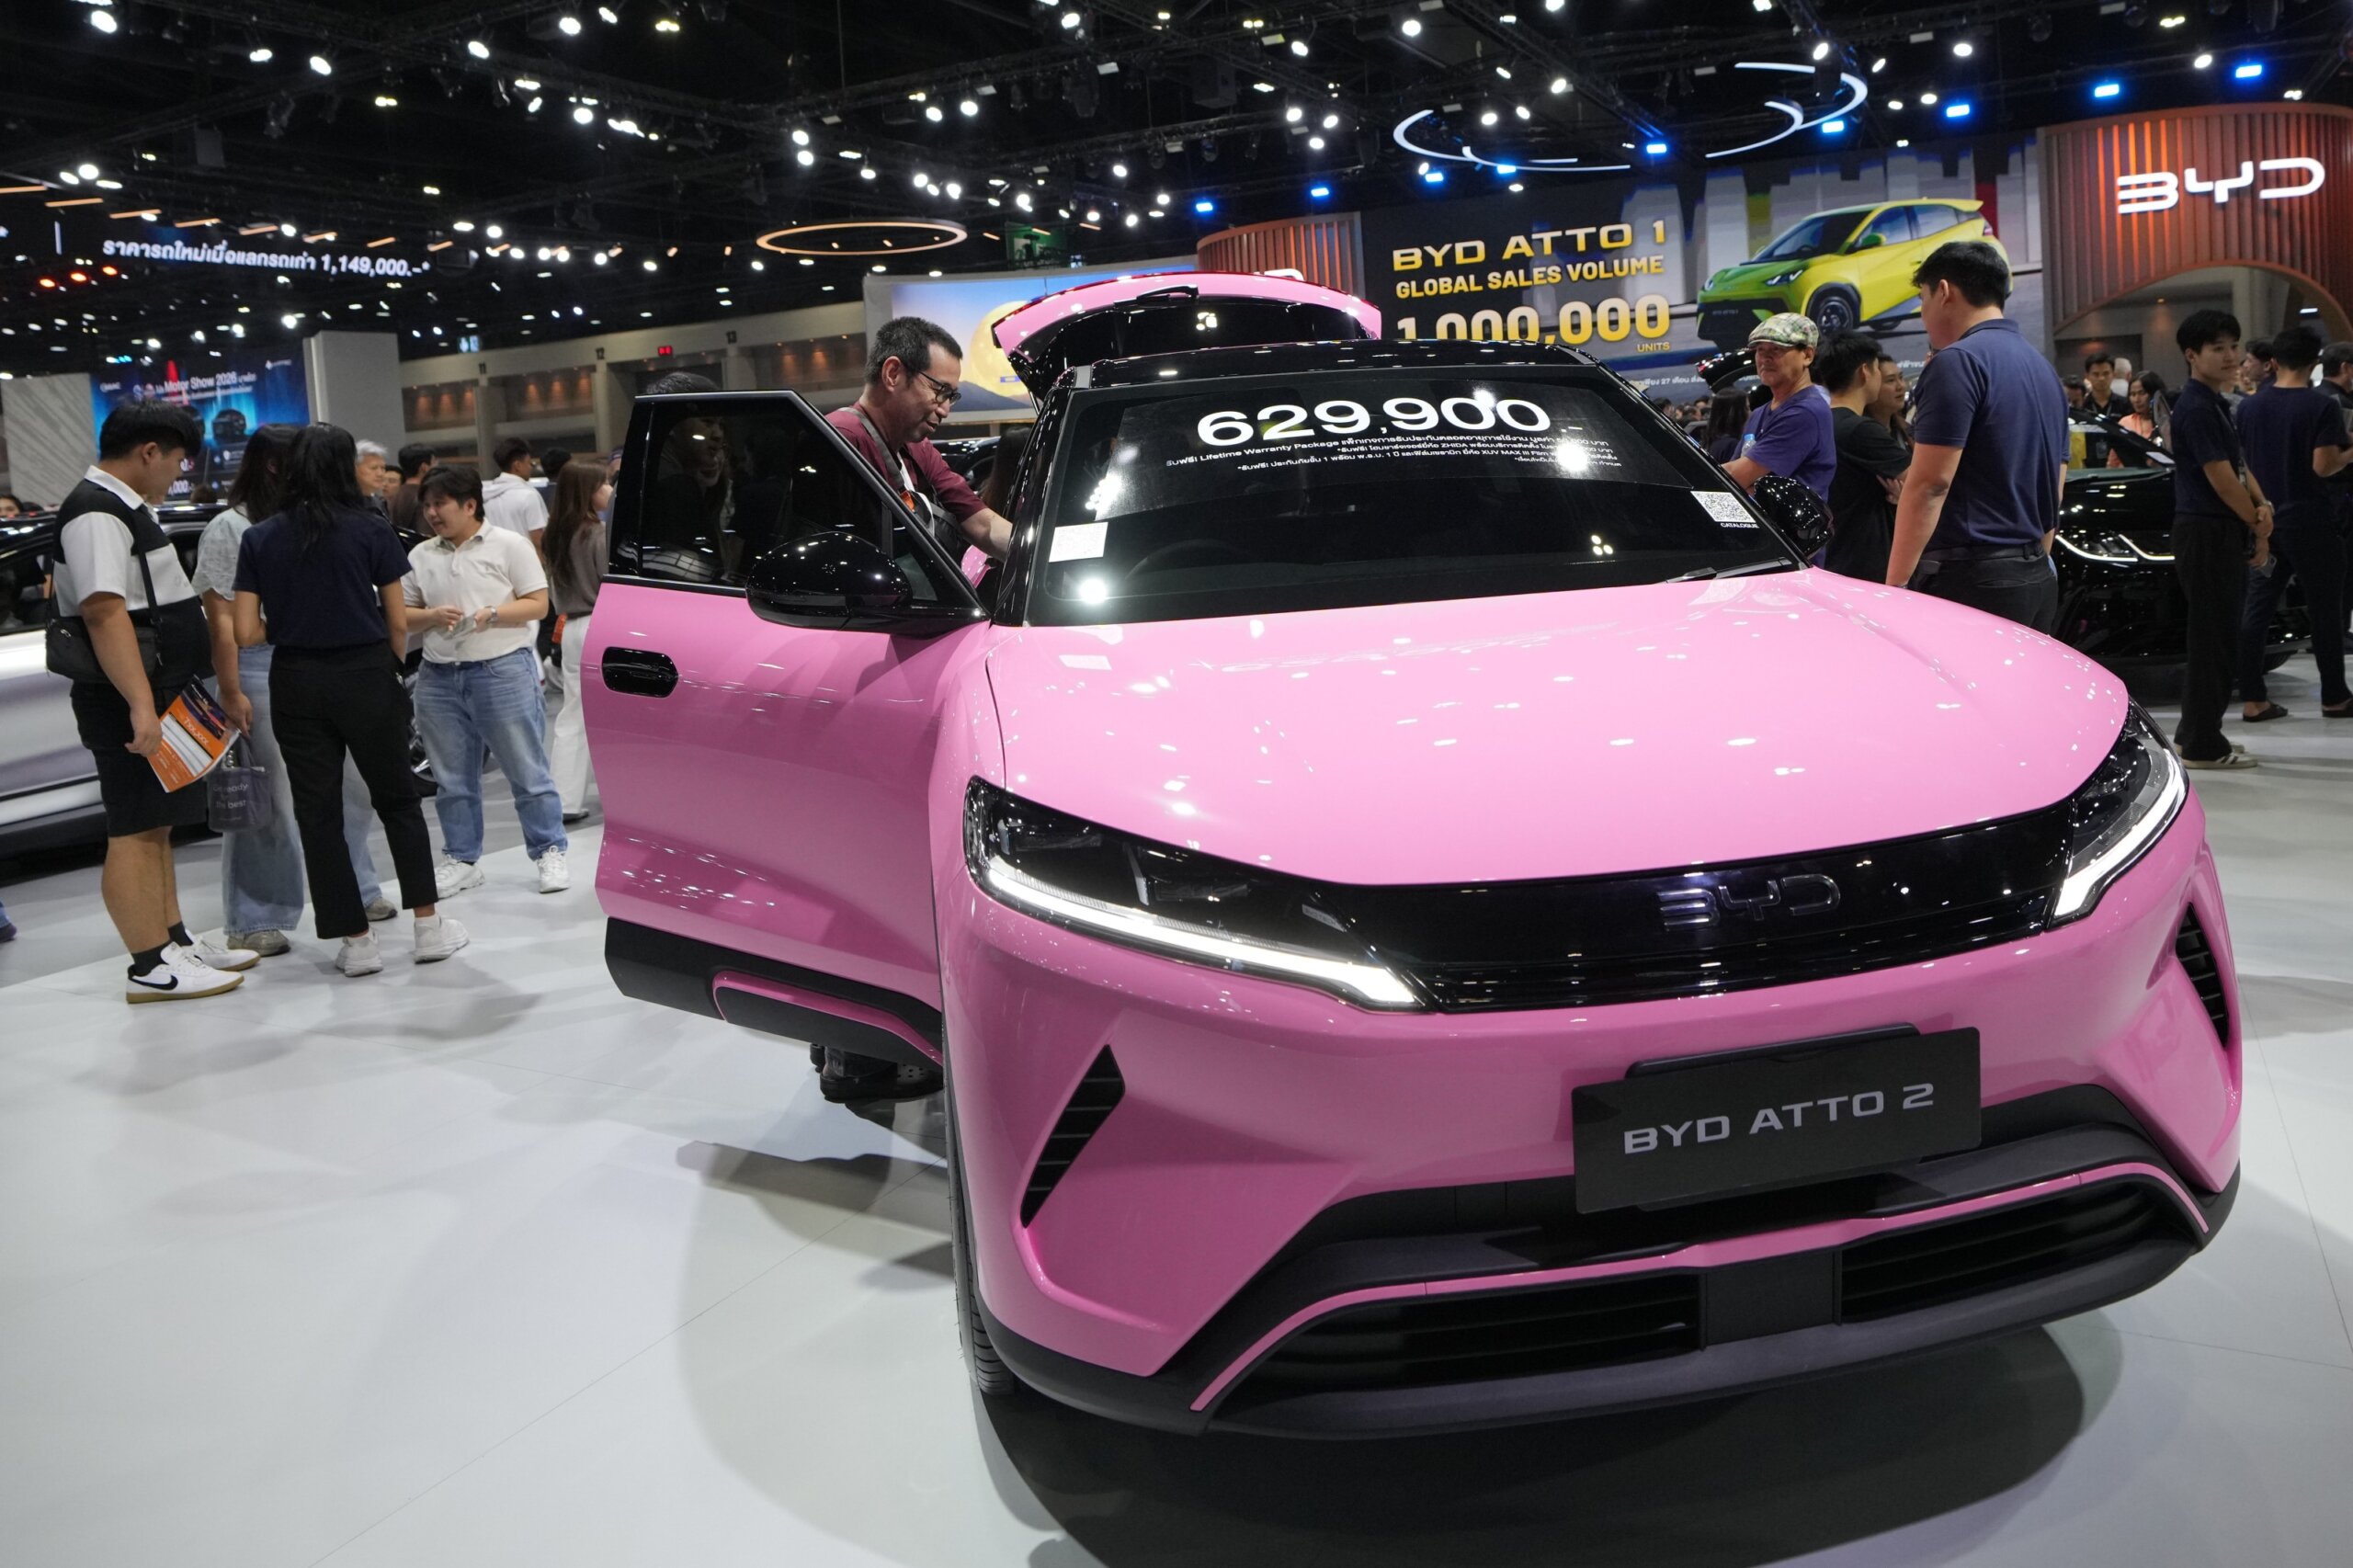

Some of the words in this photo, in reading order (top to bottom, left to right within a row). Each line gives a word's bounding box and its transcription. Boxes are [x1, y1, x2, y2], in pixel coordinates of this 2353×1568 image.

[2118, 156, 2325, 214] BYD
[102, 239, 316, 271] ราคารถใหม่เมื่อแลกรถเก่า
[1392, 241, 1486, 272] BYD
[1501, 222, 1634, 260] ATTO
[1653, 220, 1666, 244] 1
[1395, 273, 1483, 299] GLOBAL
[1487, 265, 1562, 290] SALES
[1566, 254, 1665, 282] VOLUME
[1636, 339, 1671, 354] UNITS
[190, 374, 215, 391] Show
[1199, 450, 1243, 461] Lifetime
[1244, 444, 1292, 456] Warranty
[1294, 439, 1339, 450] Package
[227, 800, 247, 810] best
[1656, 873, 1842, 932] BYD
[1624, 1115, 1731, 1155] BYD
[1749, 1090, 1884, 1135] ATTO
[1902, 1083, 1935, 1110] 2
